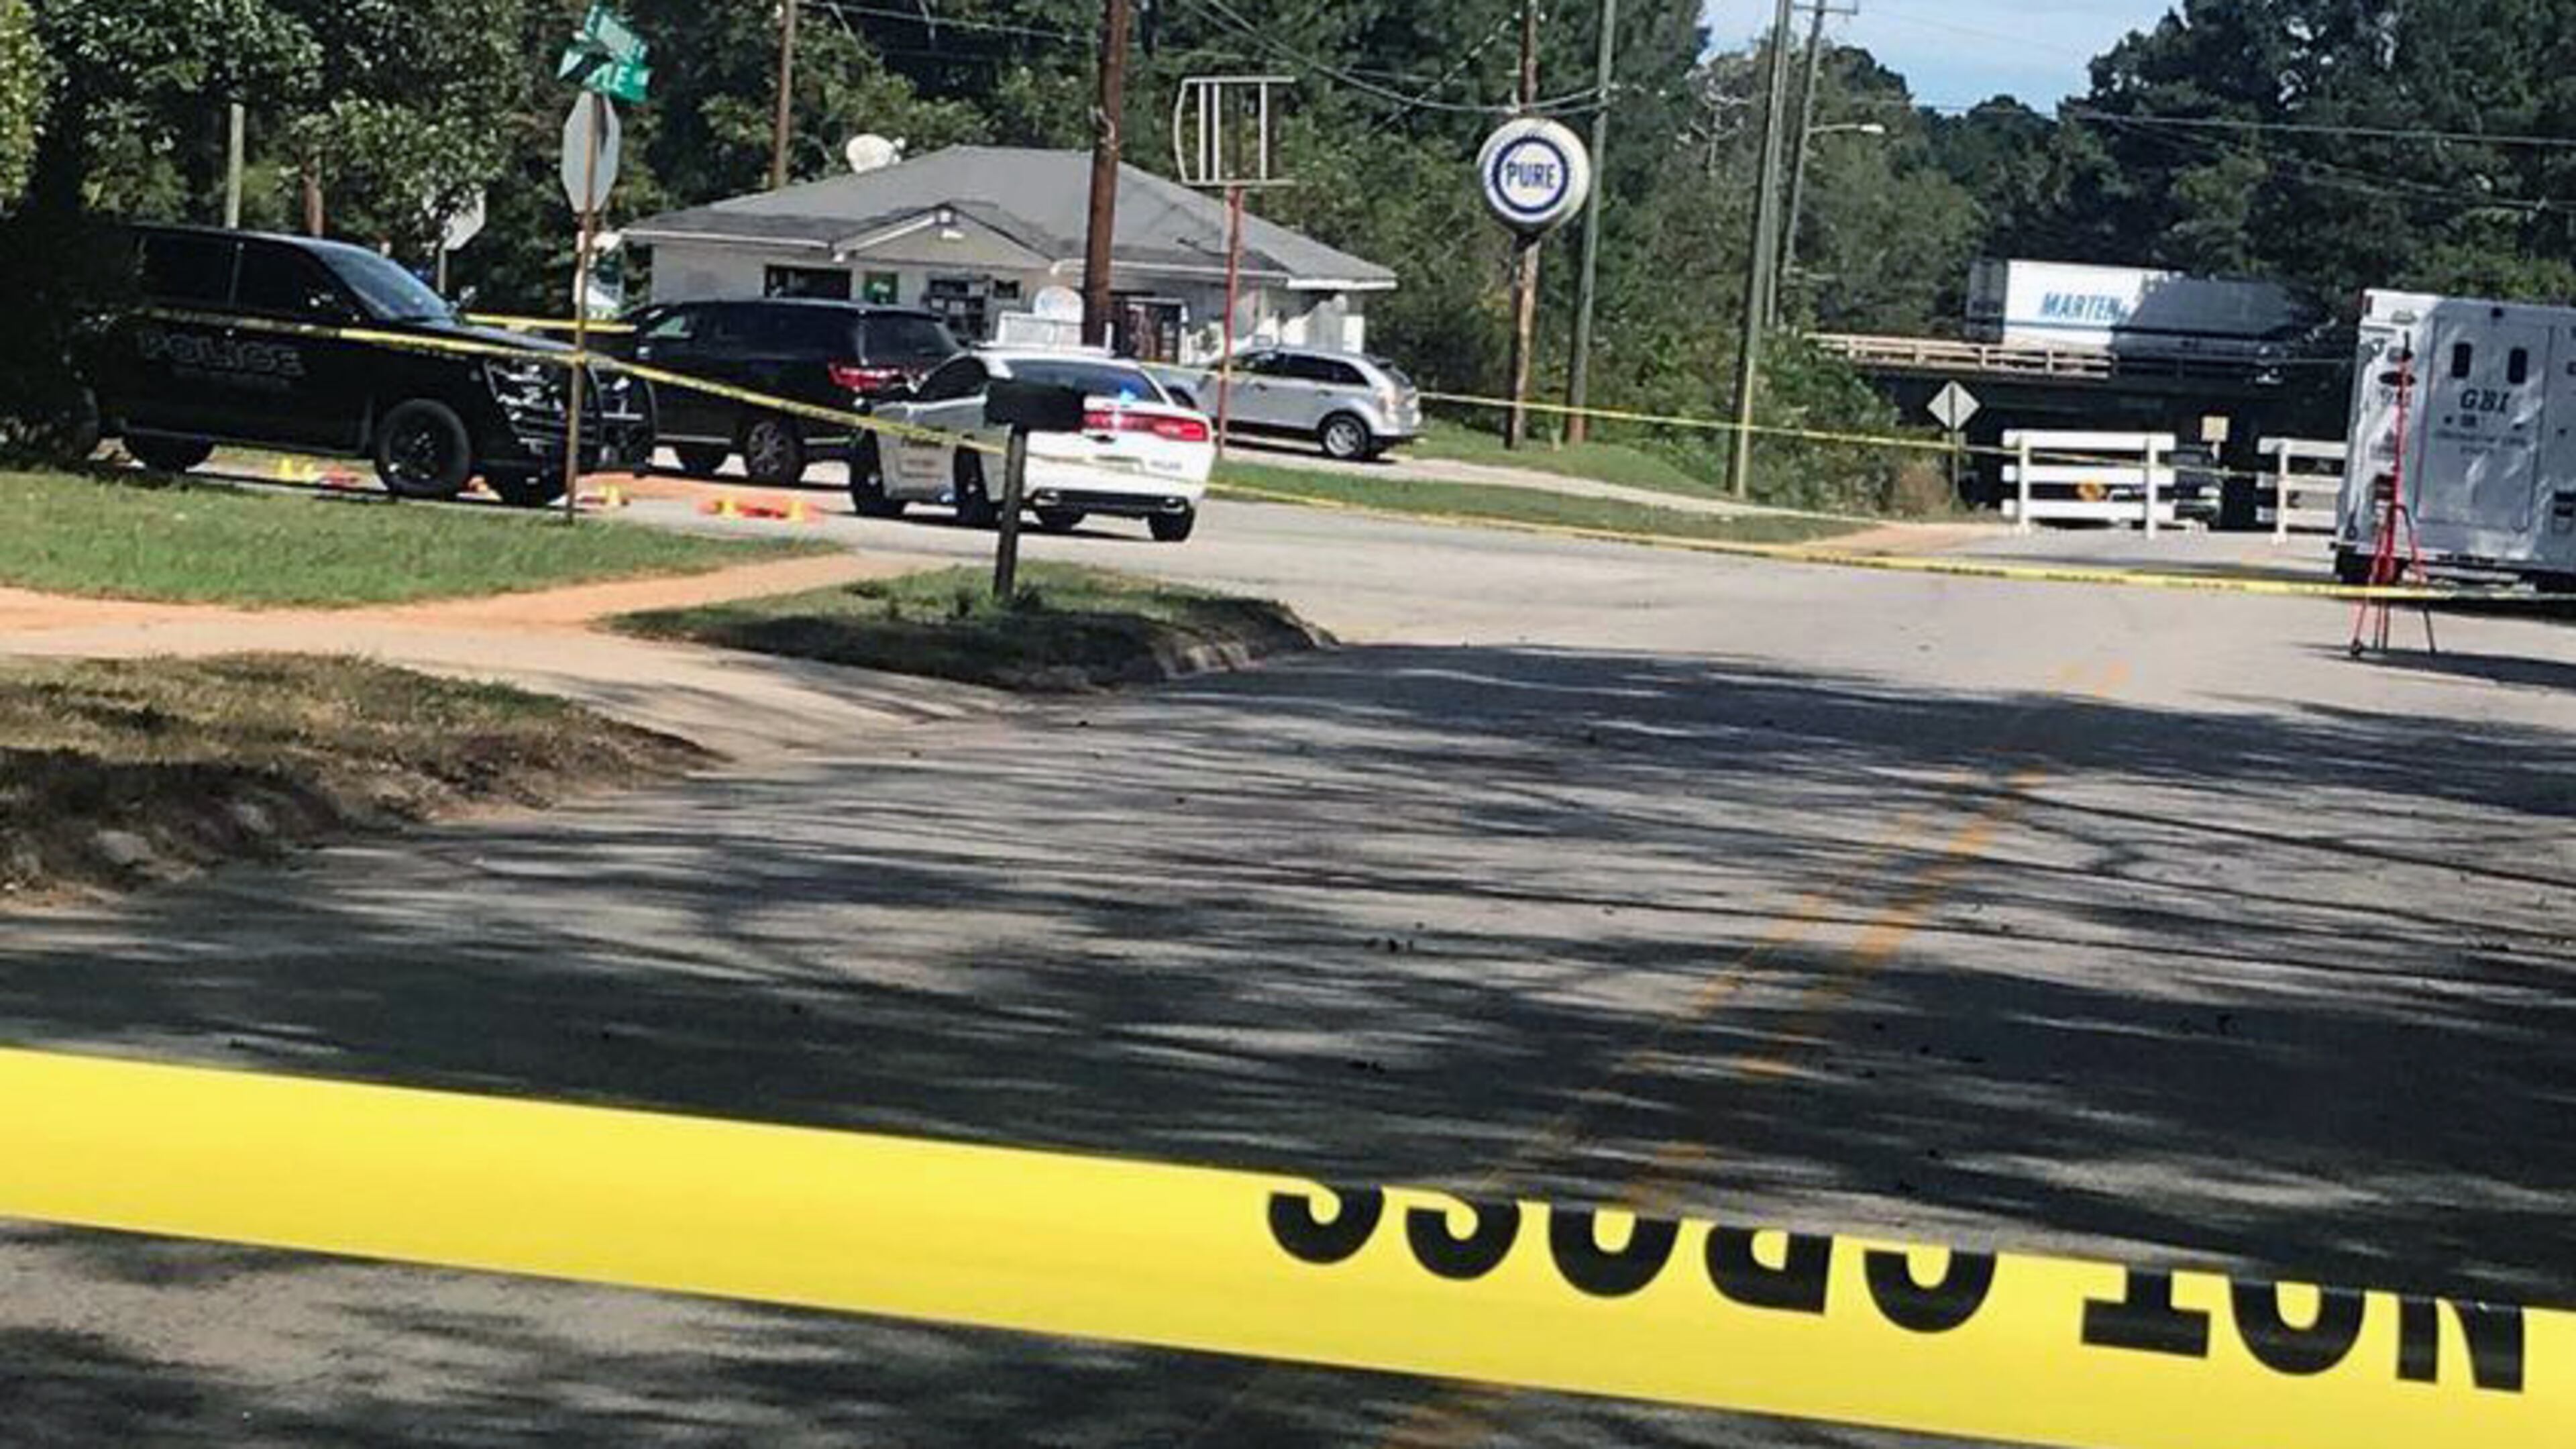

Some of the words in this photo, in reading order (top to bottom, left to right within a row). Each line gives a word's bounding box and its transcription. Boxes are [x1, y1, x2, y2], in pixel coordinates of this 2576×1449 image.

[1506, 161, 1556, 190] PURE
[2039, 291, 2123, 321] MARTEN
[137, 331, 305, 377] POLICE
[2460, 388, 2510, 415] GBI
